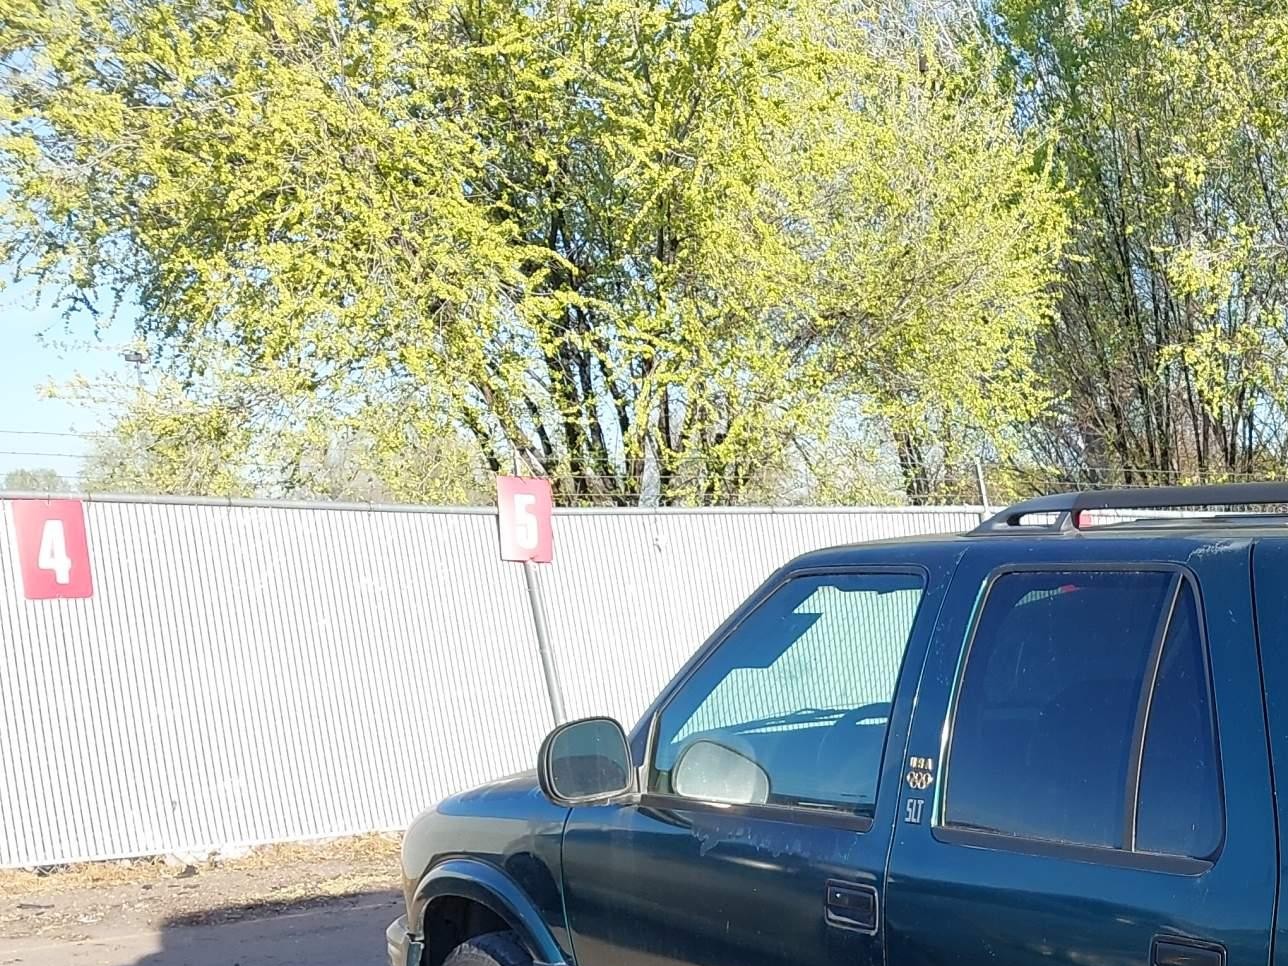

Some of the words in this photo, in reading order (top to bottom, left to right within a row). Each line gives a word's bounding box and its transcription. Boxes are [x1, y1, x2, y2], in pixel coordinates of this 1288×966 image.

[513, 493, 538, 550] 5
[38, 519, 71, 585] 4
[904, 798, 925, 823] SLT
